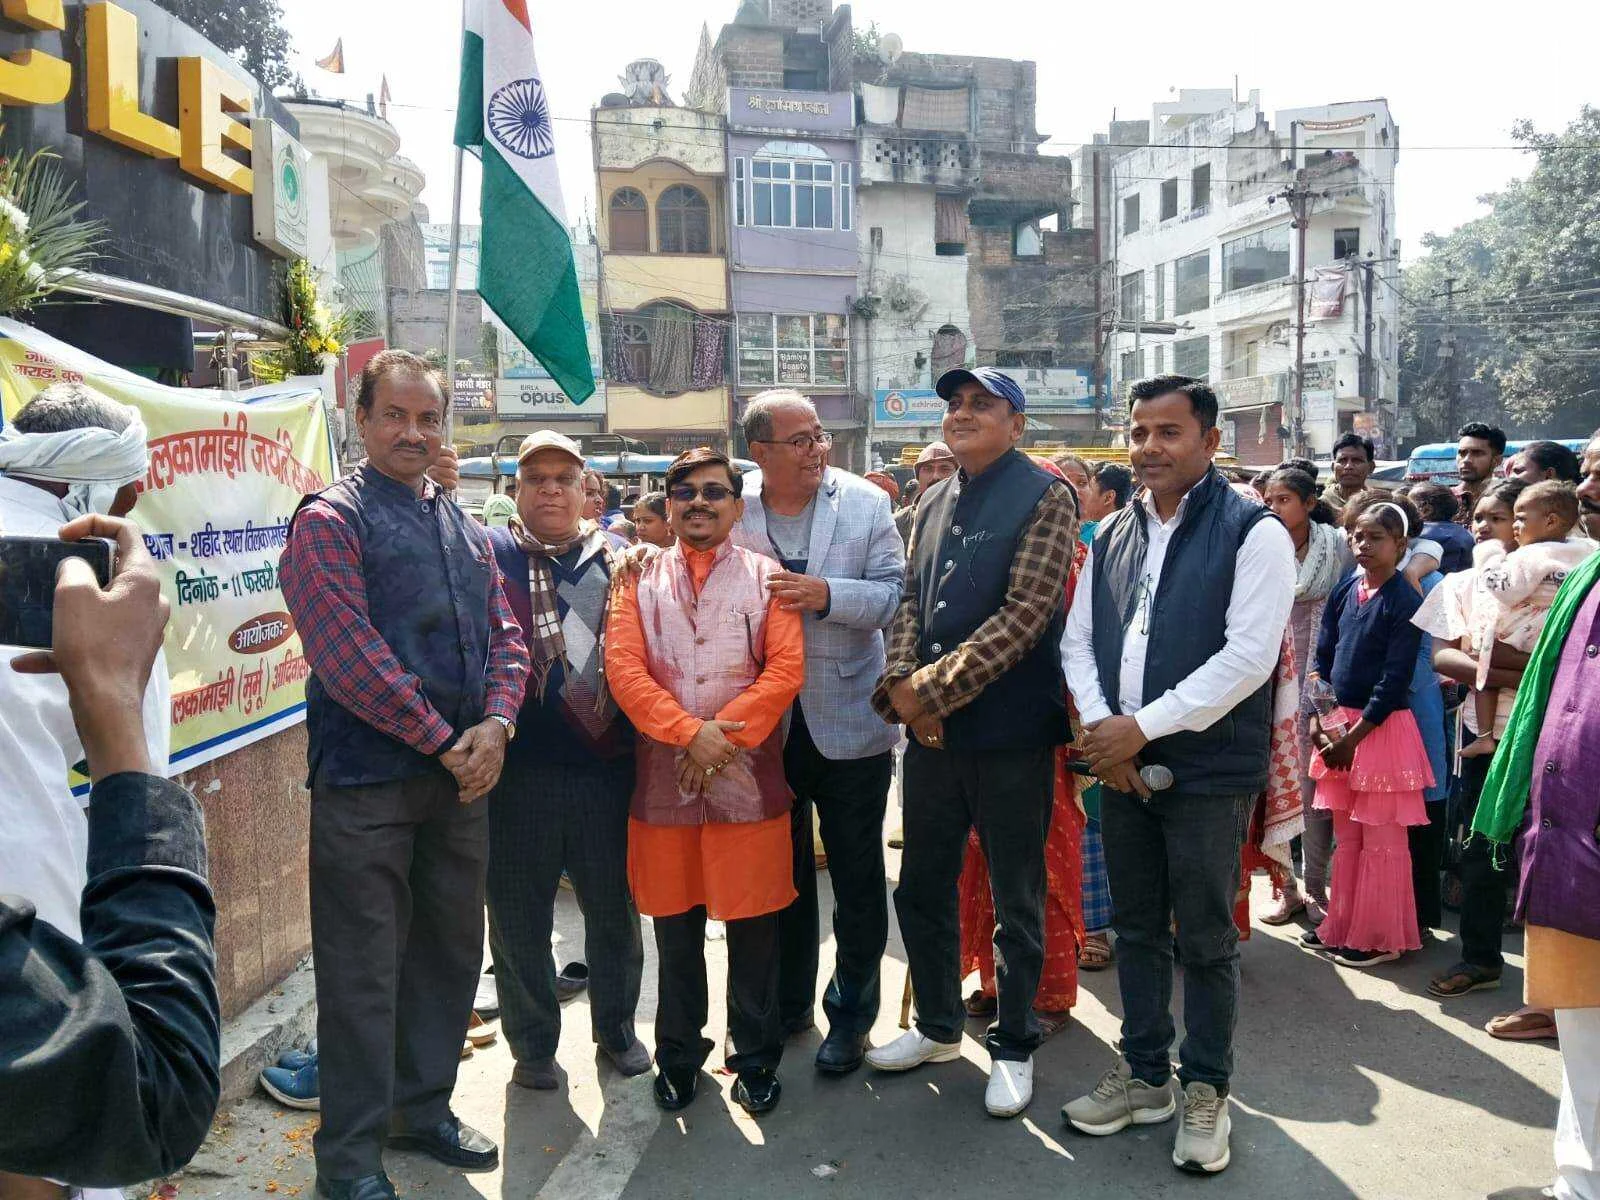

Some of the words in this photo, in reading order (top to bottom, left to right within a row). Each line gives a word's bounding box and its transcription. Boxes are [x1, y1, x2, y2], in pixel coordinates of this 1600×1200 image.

[520, 391, 565, 407] opus
[135, 411, 248, 493] लकामांझी
[190, 522, 222, 558] शहीद
[222, 528, 245, 556] स्थल
[175, 567, 220, 606] दिनांक
[242, 560, 274, 594] फरवरी
[171, 666, 236, 725] लकामांझी
